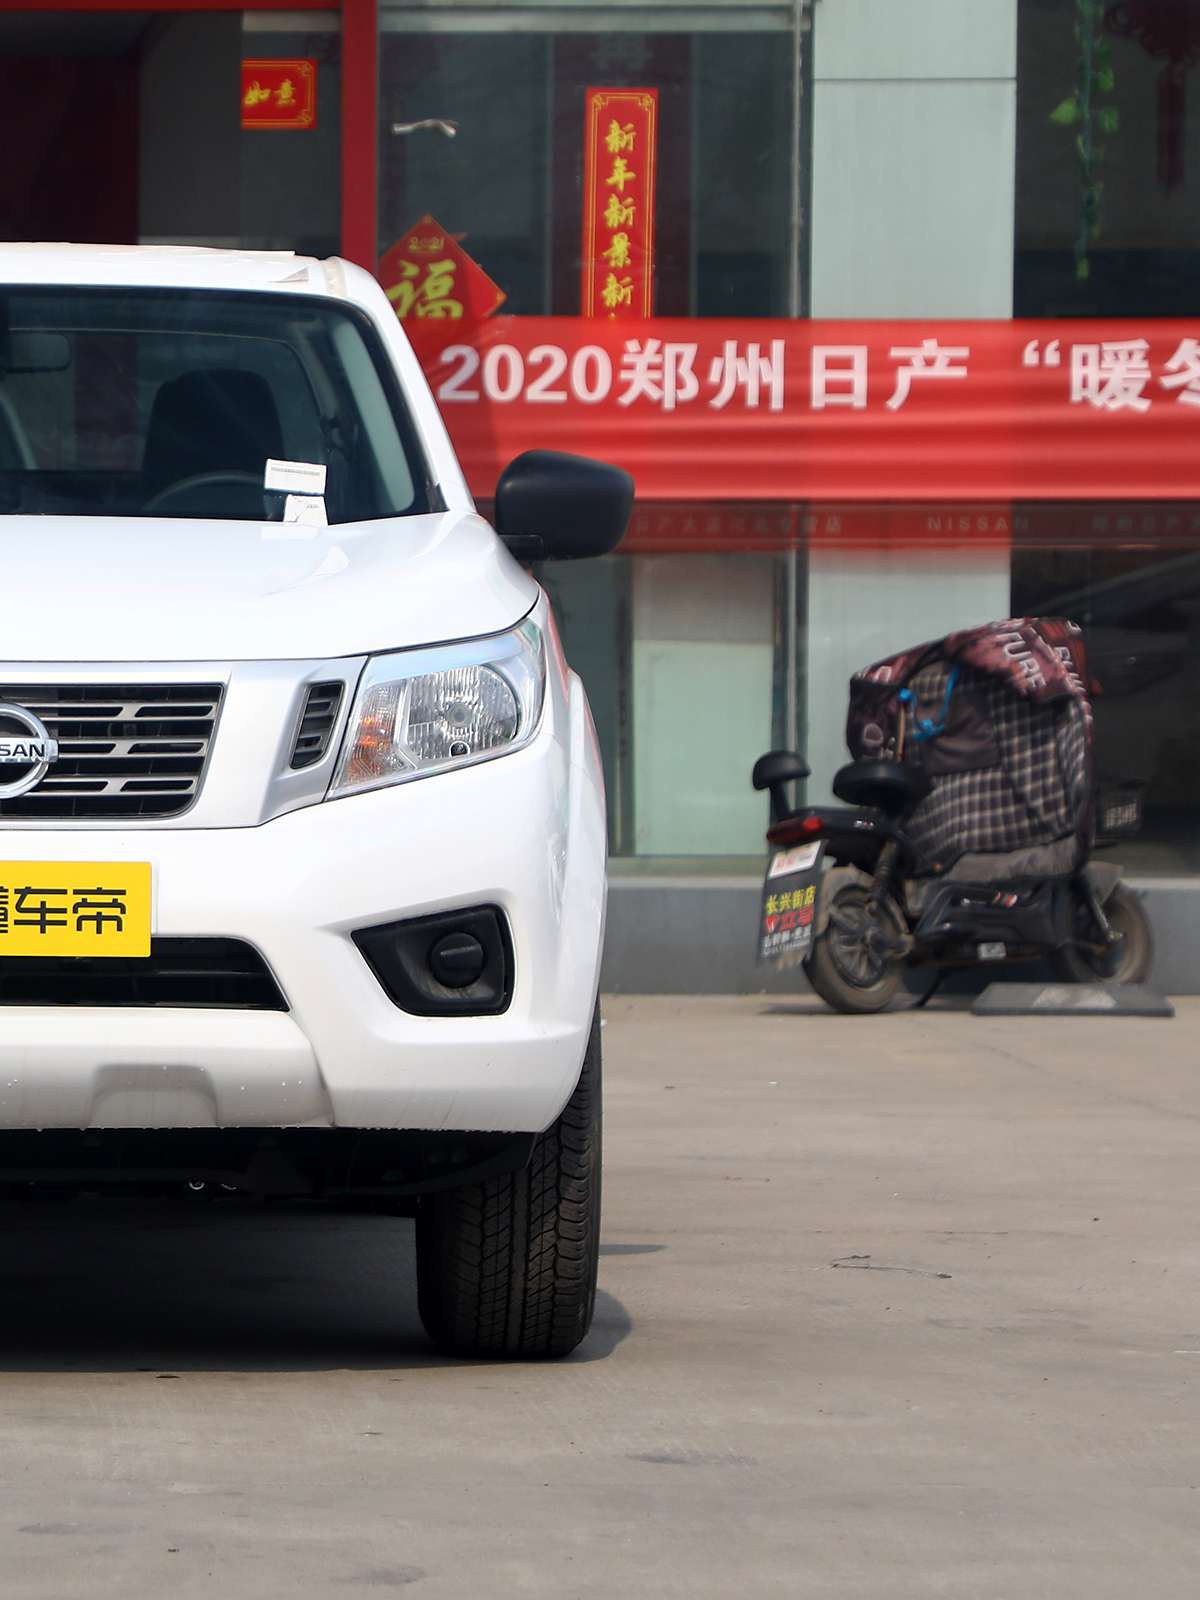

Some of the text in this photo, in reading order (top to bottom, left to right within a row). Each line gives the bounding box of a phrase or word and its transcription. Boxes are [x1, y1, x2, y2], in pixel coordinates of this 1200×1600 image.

[244, 80, 297, 105] 如意
[602, 119, 637, 317] 新年新景新
[926, 515, 1030, 533] NISSAN
